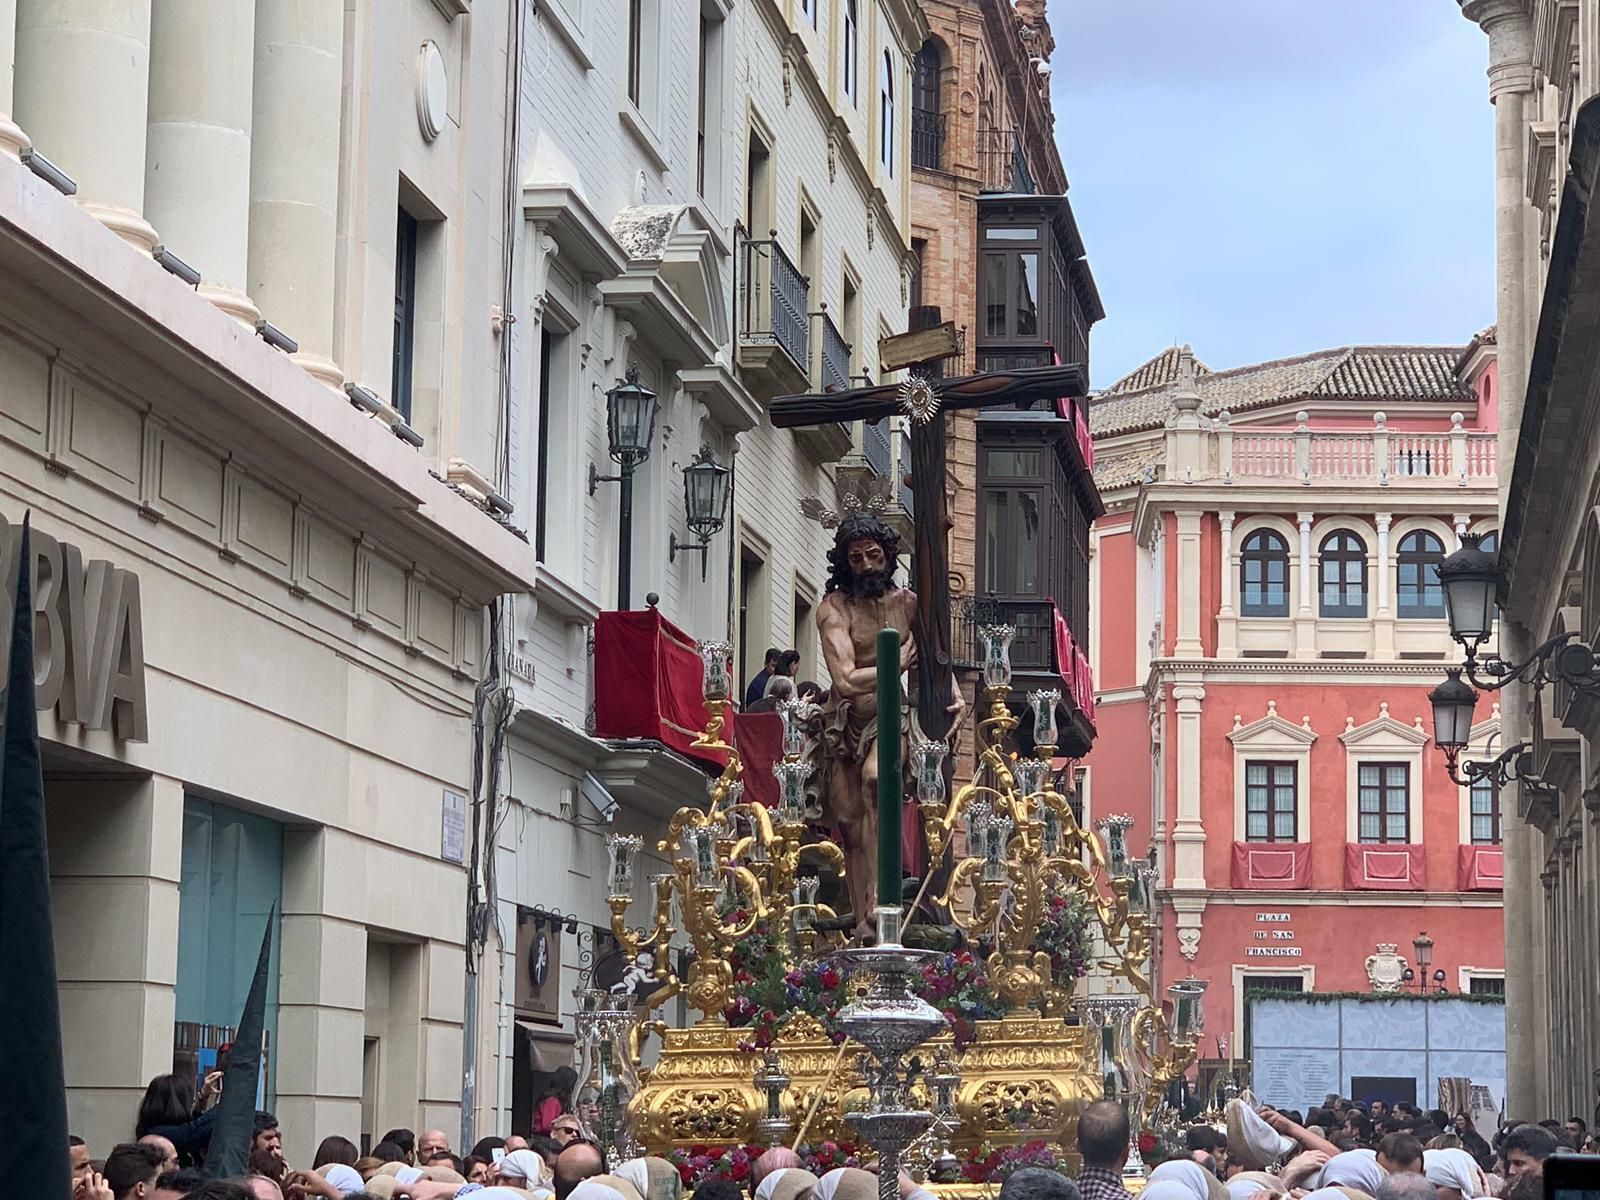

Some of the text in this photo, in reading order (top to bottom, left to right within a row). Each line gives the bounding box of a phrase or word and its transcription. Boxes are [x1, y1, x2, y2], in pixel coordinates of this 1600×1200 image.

[1256, 913, 1290, 921] PLAZA
[1254, 931, 1294, 939] DE SAN
[1245, 948, 1301, 956] FRANCISCO
